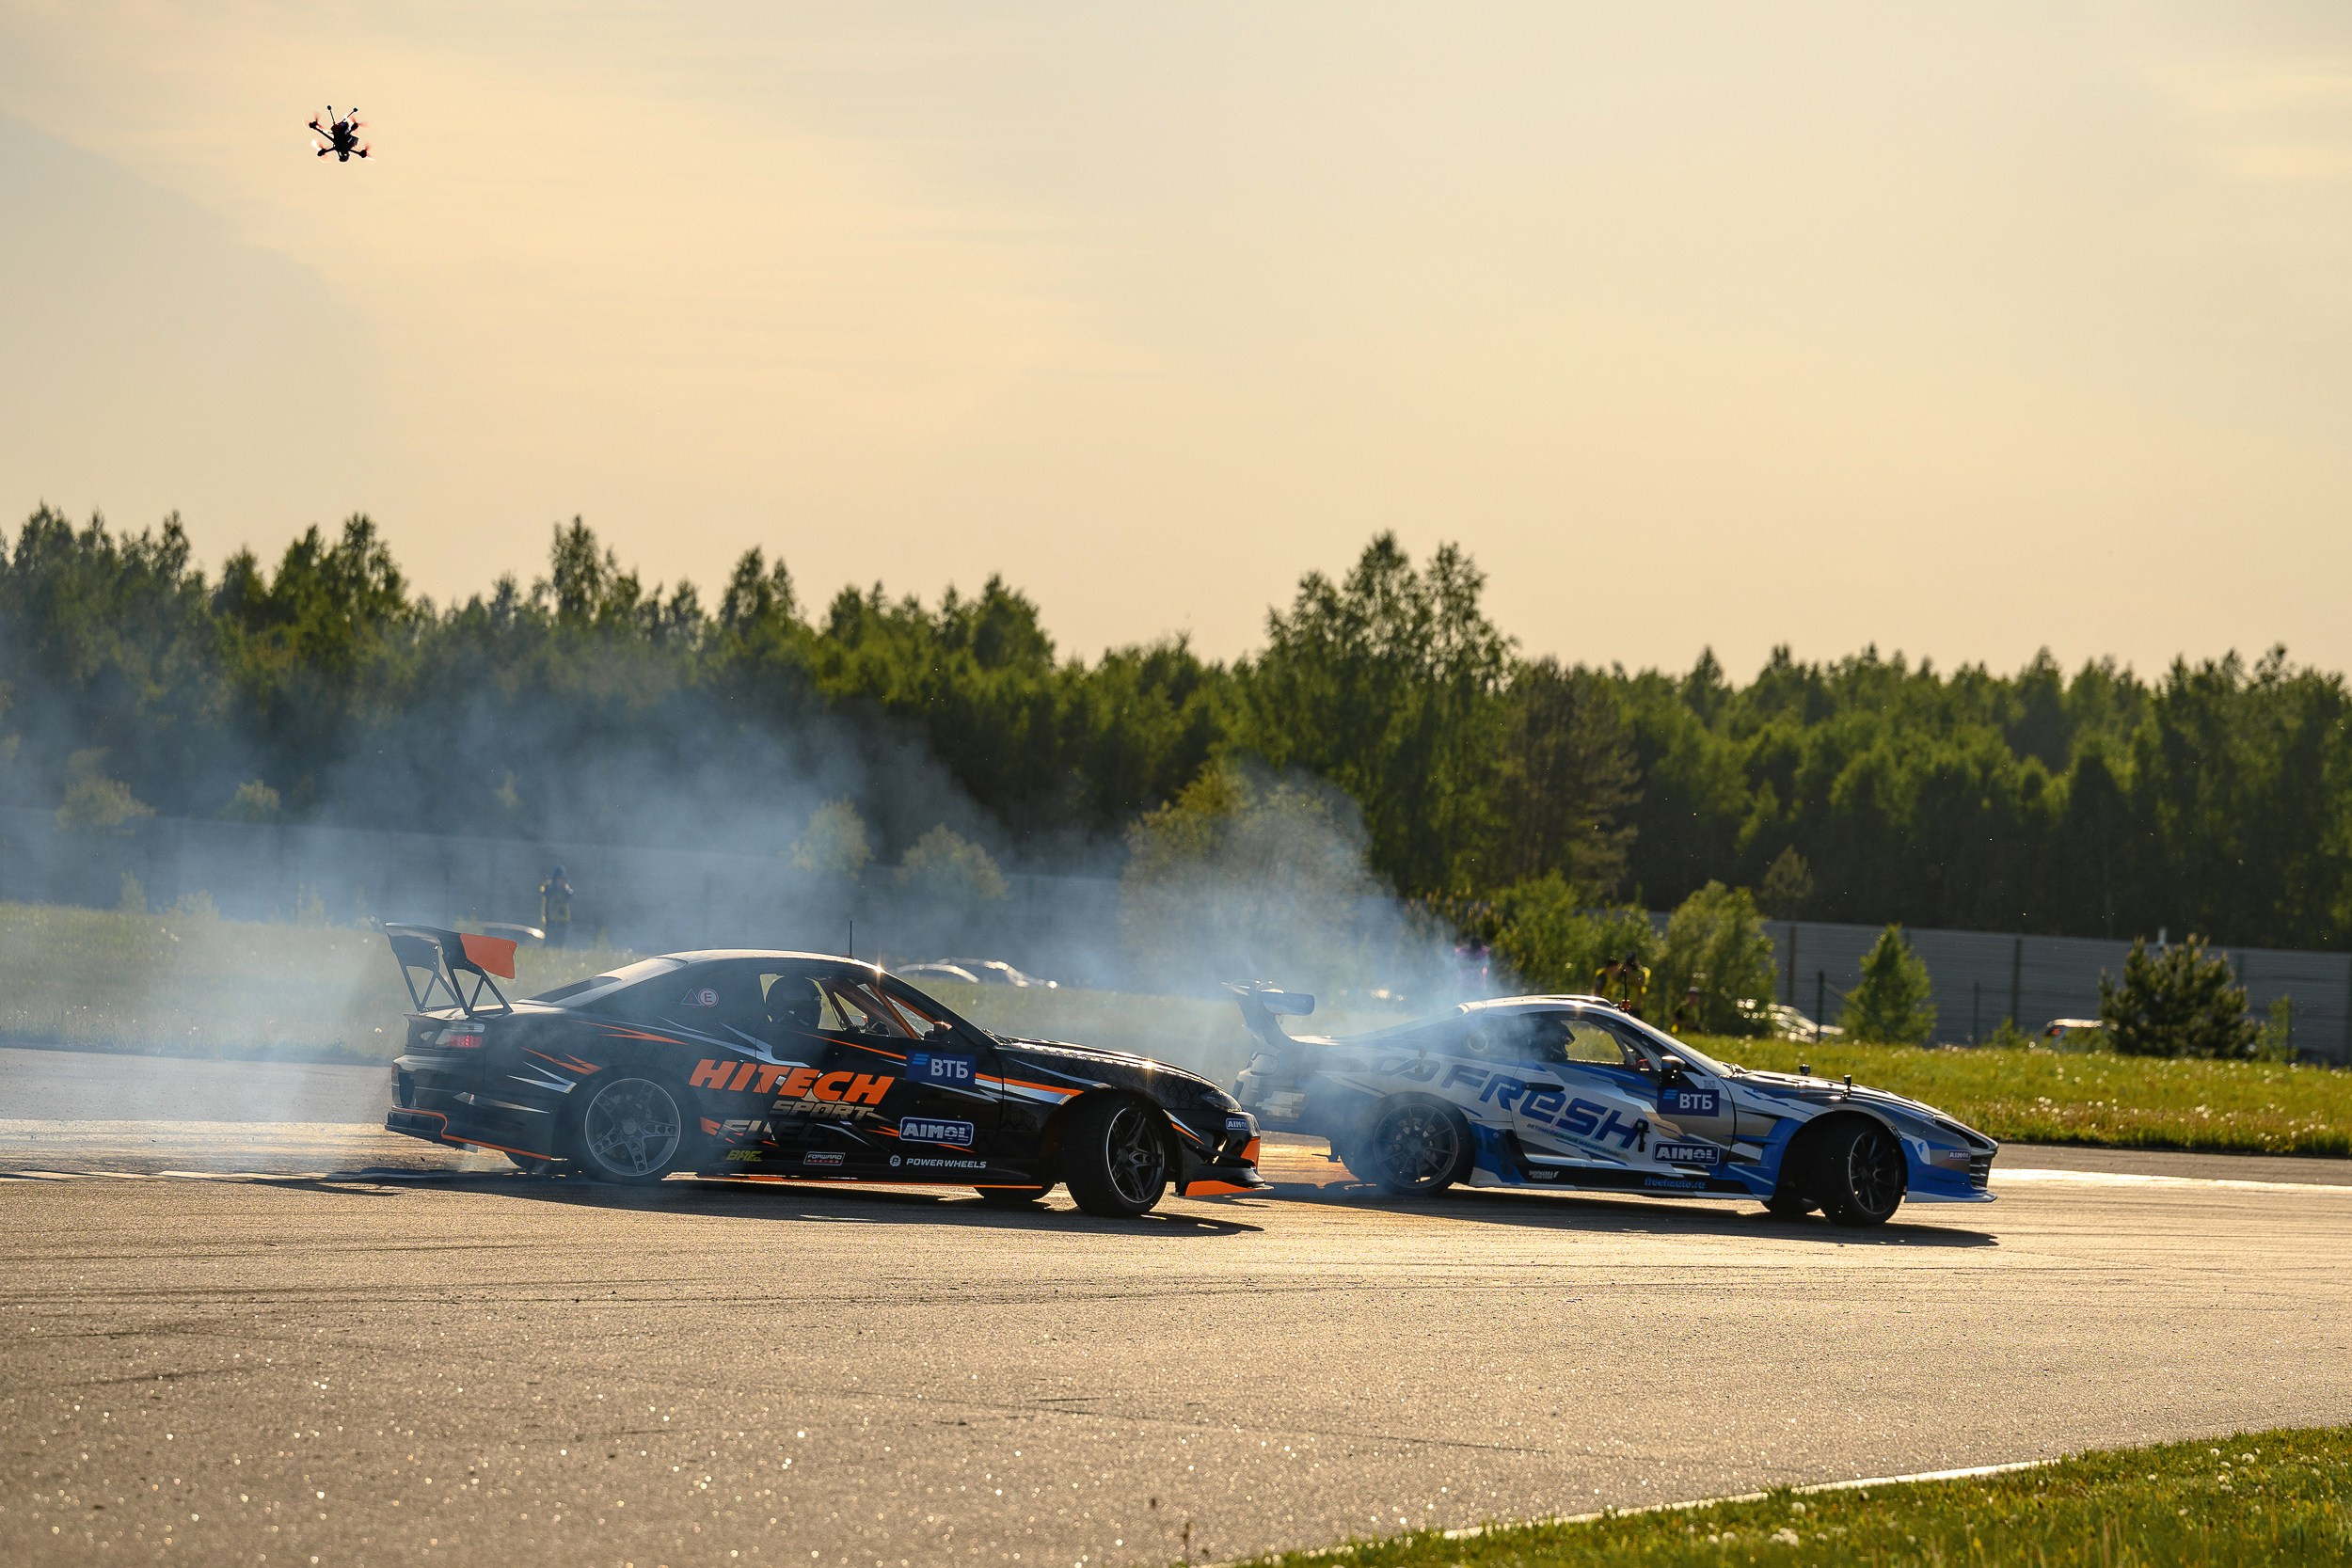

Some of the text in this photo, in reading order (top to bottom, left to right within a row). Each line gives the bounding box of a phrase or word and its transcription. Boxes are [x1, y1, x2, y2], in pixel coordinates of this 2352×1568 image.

[930, 1058, 969, 1079] ВТБ
[689, 1058, 895, 1105] HITECH
[770, 1100, 877, 1121] SPORT
[1679, 1093, 1713, 1110] ВТБ
[903, 1122, 970, 1141] AIMOL
[1656, 1147, 1716, 1162] AIMOL
